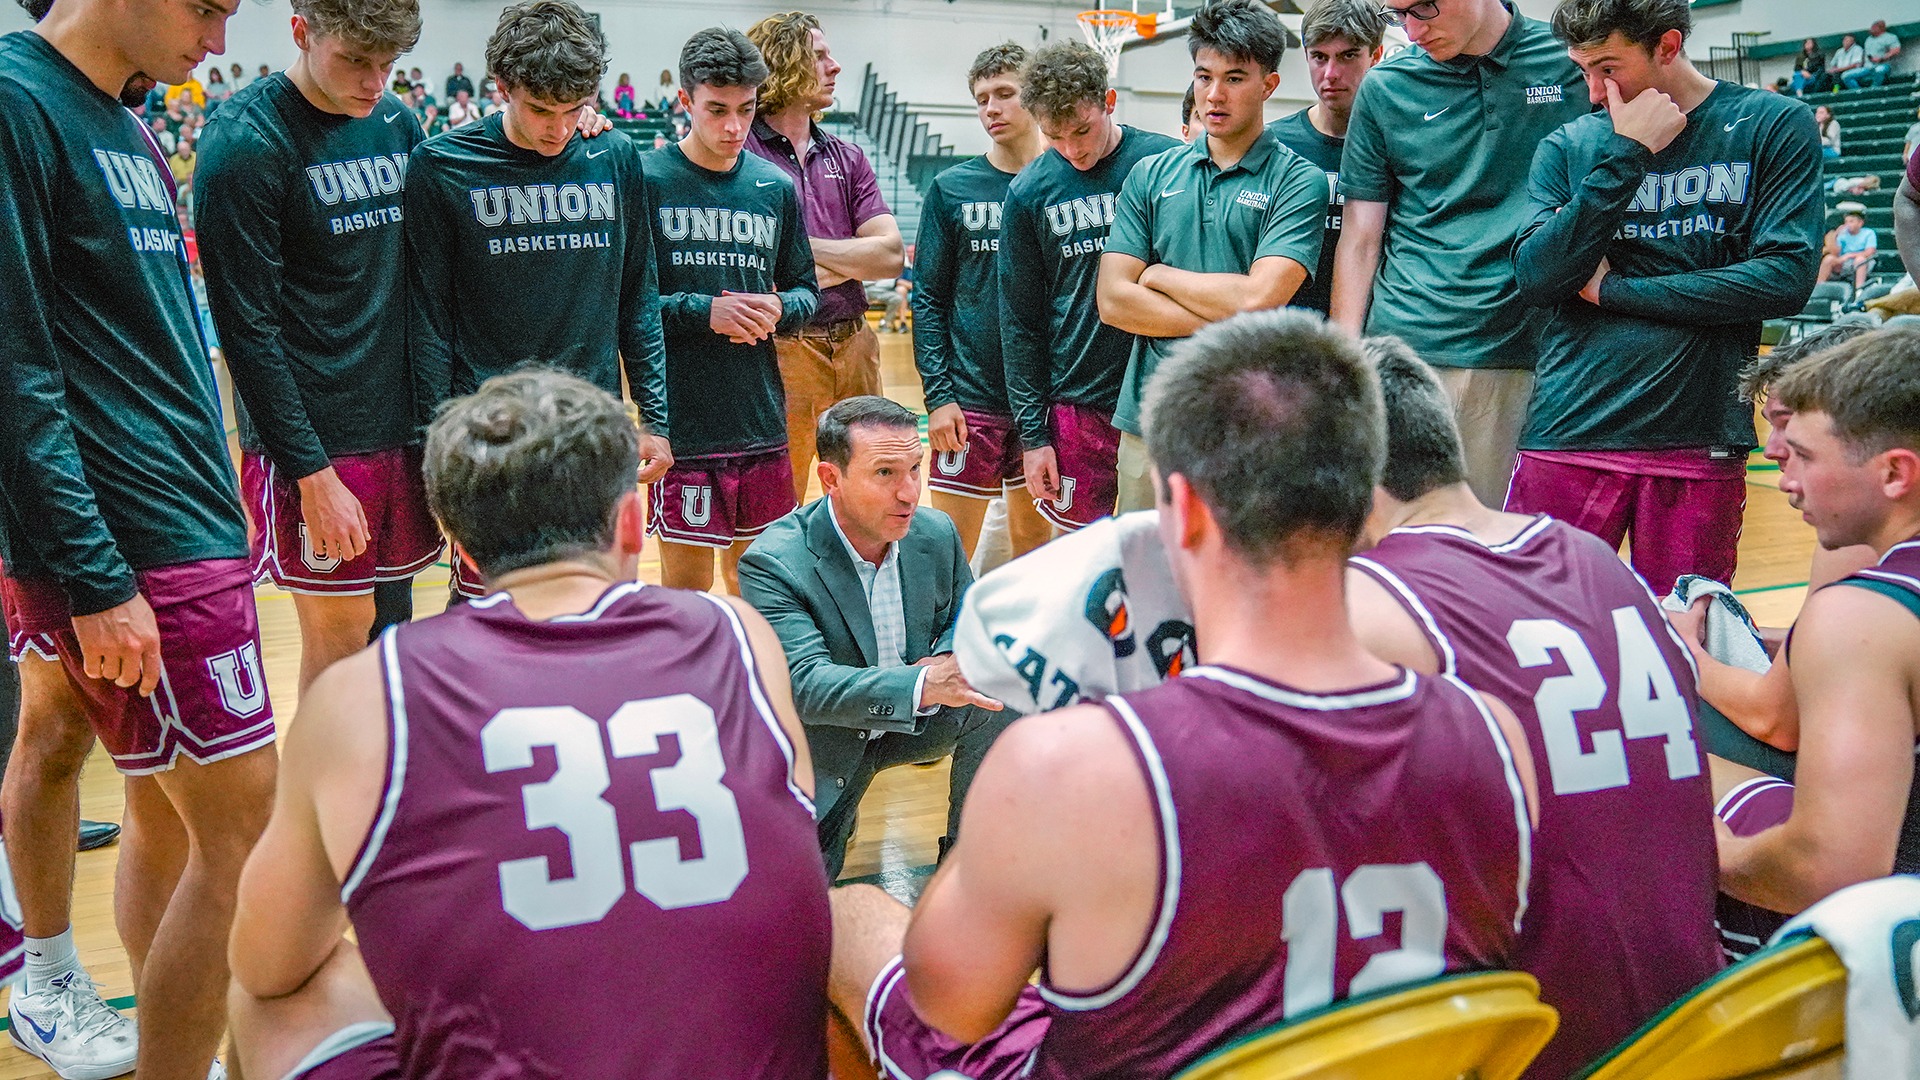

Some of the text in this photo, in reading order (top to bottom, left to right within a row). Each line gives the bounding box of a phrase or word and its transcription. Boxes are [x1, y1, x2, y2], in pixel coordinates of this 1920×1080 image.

[1525, 84, 1562, 97] UNION
[1526, 94, 1563, 105] BASKETBALL
[470, 182, 616, 228] UNION
[1239, 189, 1271, 204] UNION
[488, 232, 611, 255] BASKETBALL
[658, 207, 777, 250] UNION
[681, 484, 712, 528] U
[205, 639, 266, 720] U
[1506, 605, 1701, 796] 24
[479, 692, 750, 932] 33
